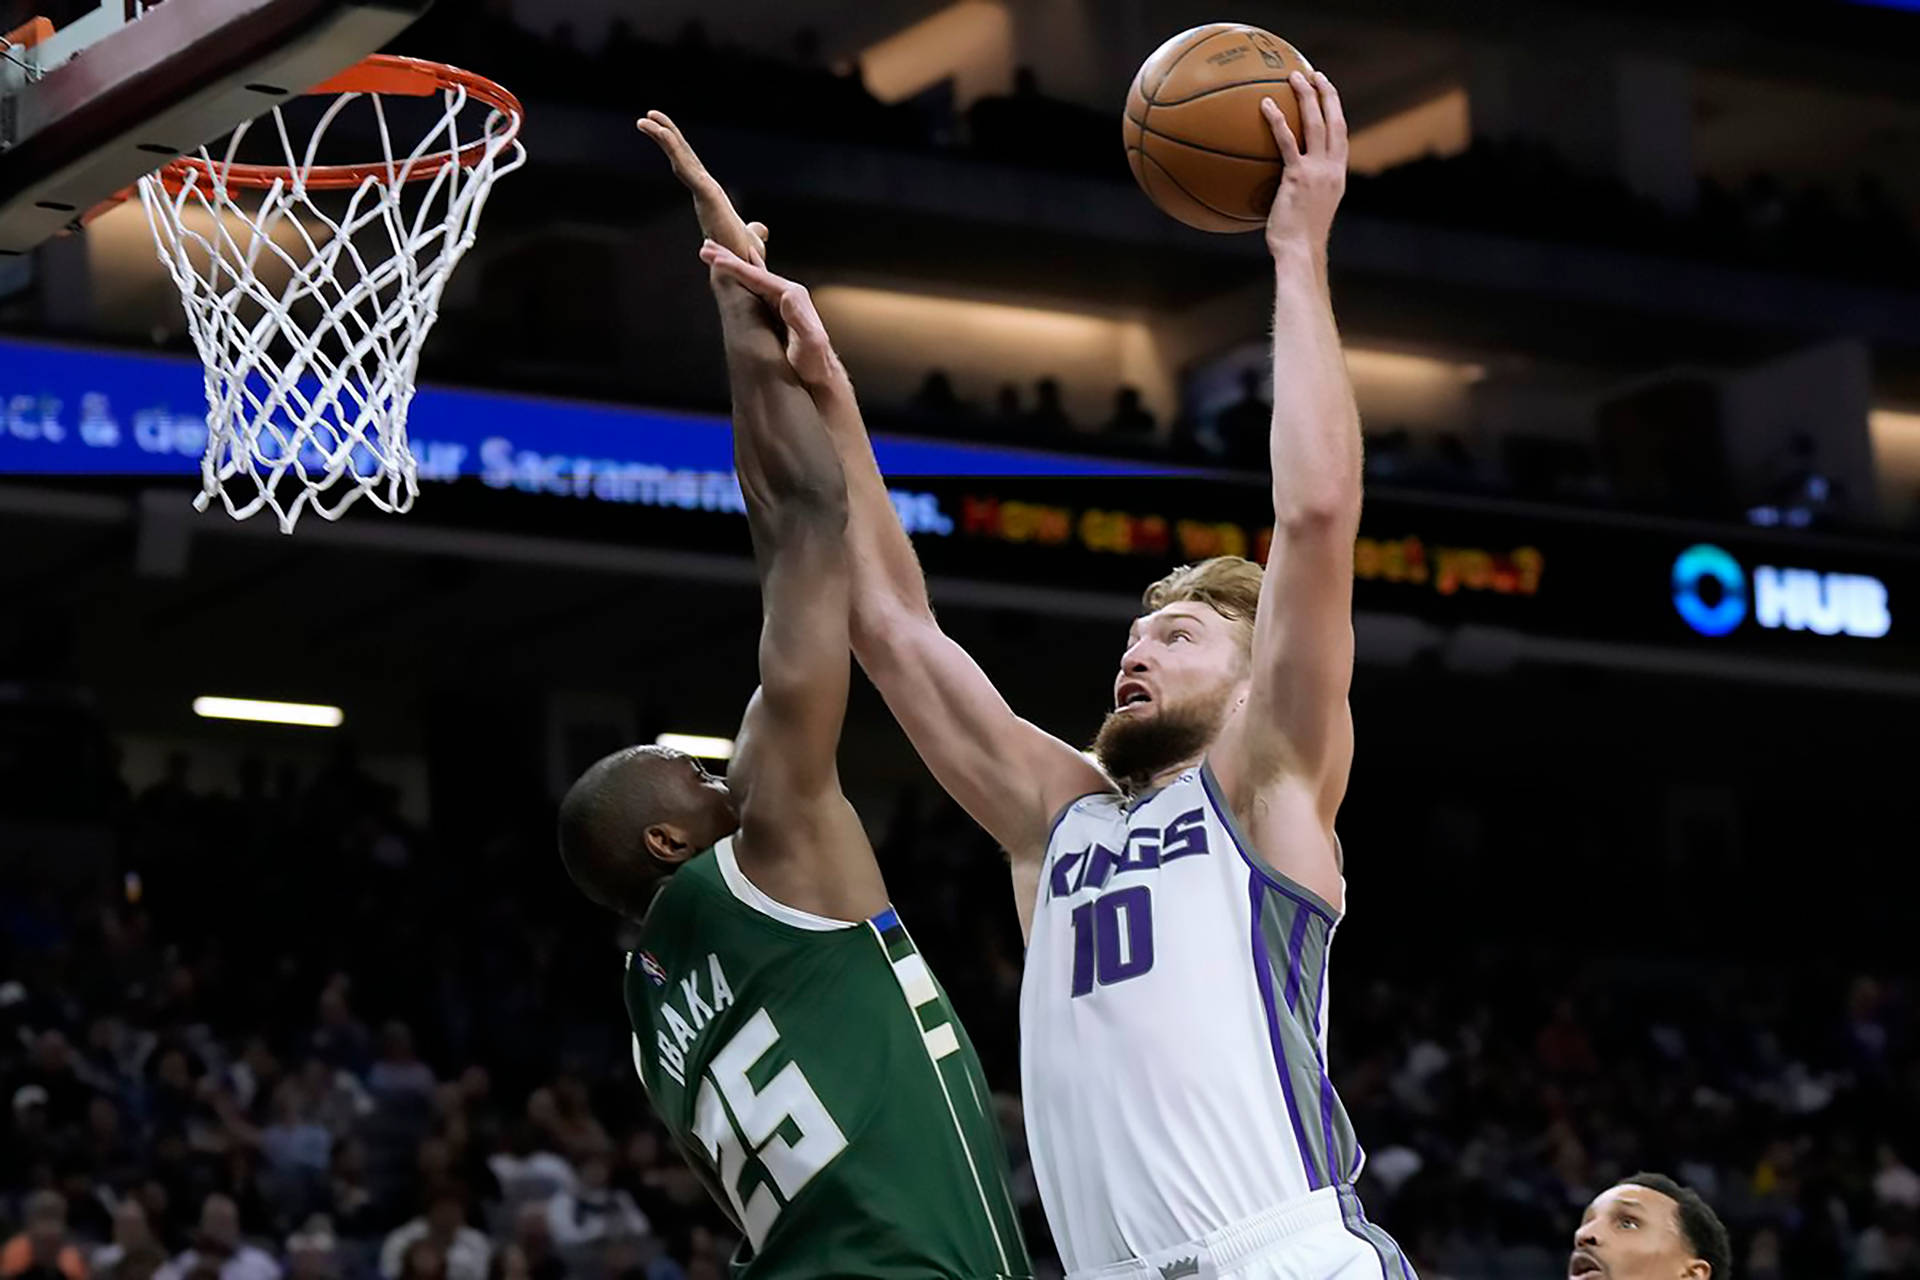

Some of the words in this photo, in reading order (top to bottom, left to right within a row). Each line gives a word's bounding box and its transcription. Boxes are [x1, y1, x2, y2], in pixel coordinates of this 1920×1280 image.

[480, 437, 748, 514] Sacramen
[960, 491, 1073, 546] How
[1435, 545, 1545, 597] you?
[1754, 565, 1891, 638] HUB
[1071, 885, 1155, 998] 10
[659, 952, 735, 1087] IBAKA
[692, 1006, 849, 1256] 25
